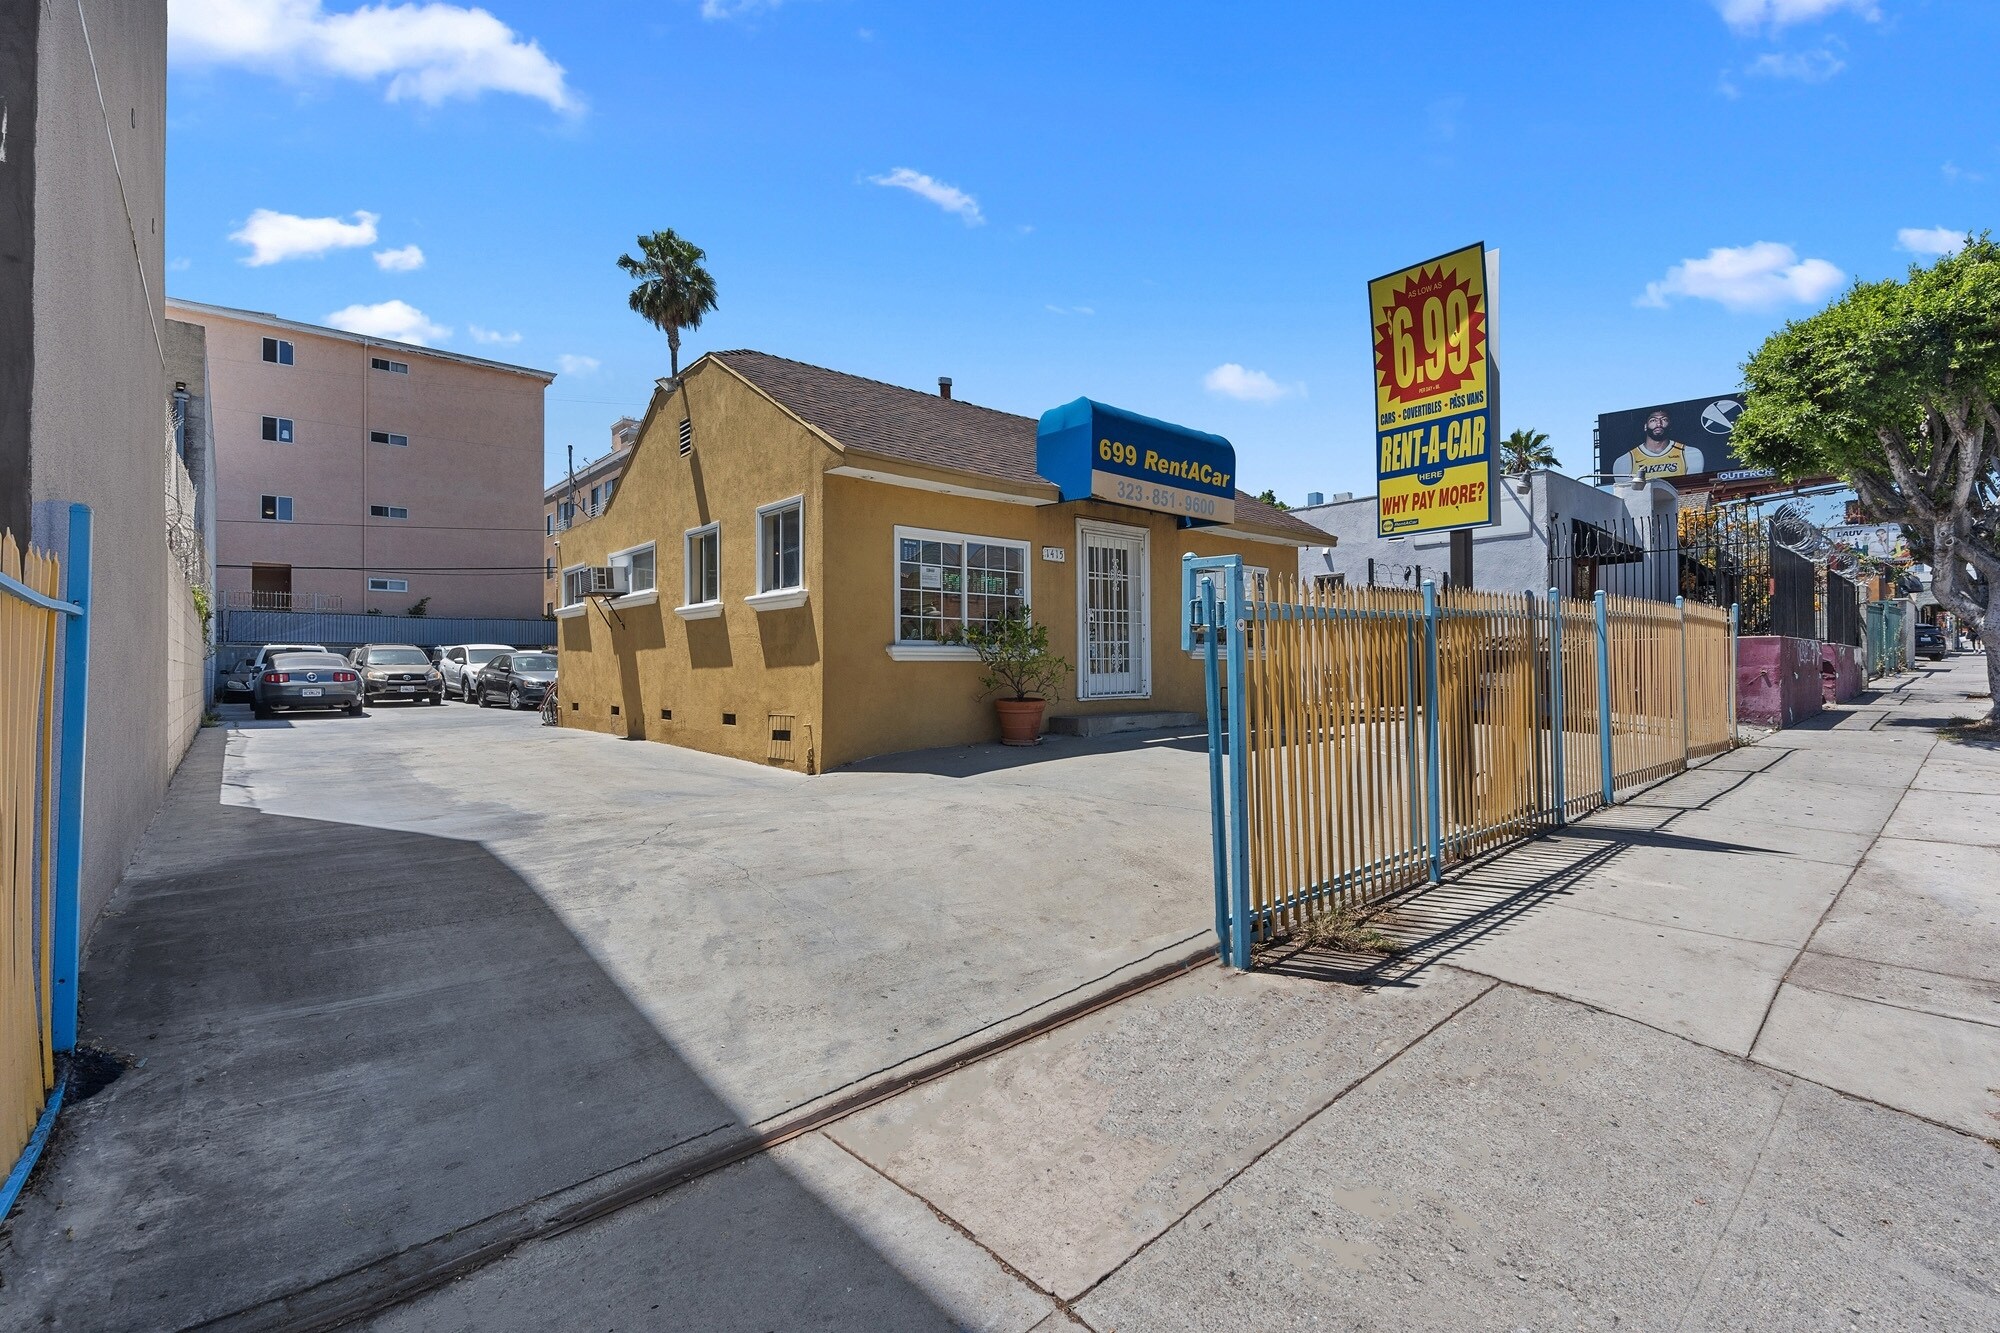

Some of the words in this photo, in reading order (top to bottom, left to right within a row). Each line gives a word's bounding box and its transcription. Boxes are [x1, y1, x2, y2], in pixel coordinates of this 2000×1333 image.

[1408, 290, 1416, 298] AS
[1418, 285, 1432, 296] LOW
[1434, 281, 1442, 290] AS
[1380, 412, 1396, 425] CARS
[1403, 401, 1441, 420] COVERTIBLES
[1450, 395, 1465, 410] PASS
[1467, 391, 1483, 404] VANS
[1380, 415, 1485, 473] RENT-A-CAR
[1099, 439, 1137, 466] 699
[1144, 450, 1230, 488] RentACar
[1420, 471, 1442, 480] HERE
[1382, 494, 1409, 515] WHY
[1412, 489, 1436, 511] PAY
[1439, 482, 1485, 506] MORE?
[1047, 549, 1063, 559] 1415
